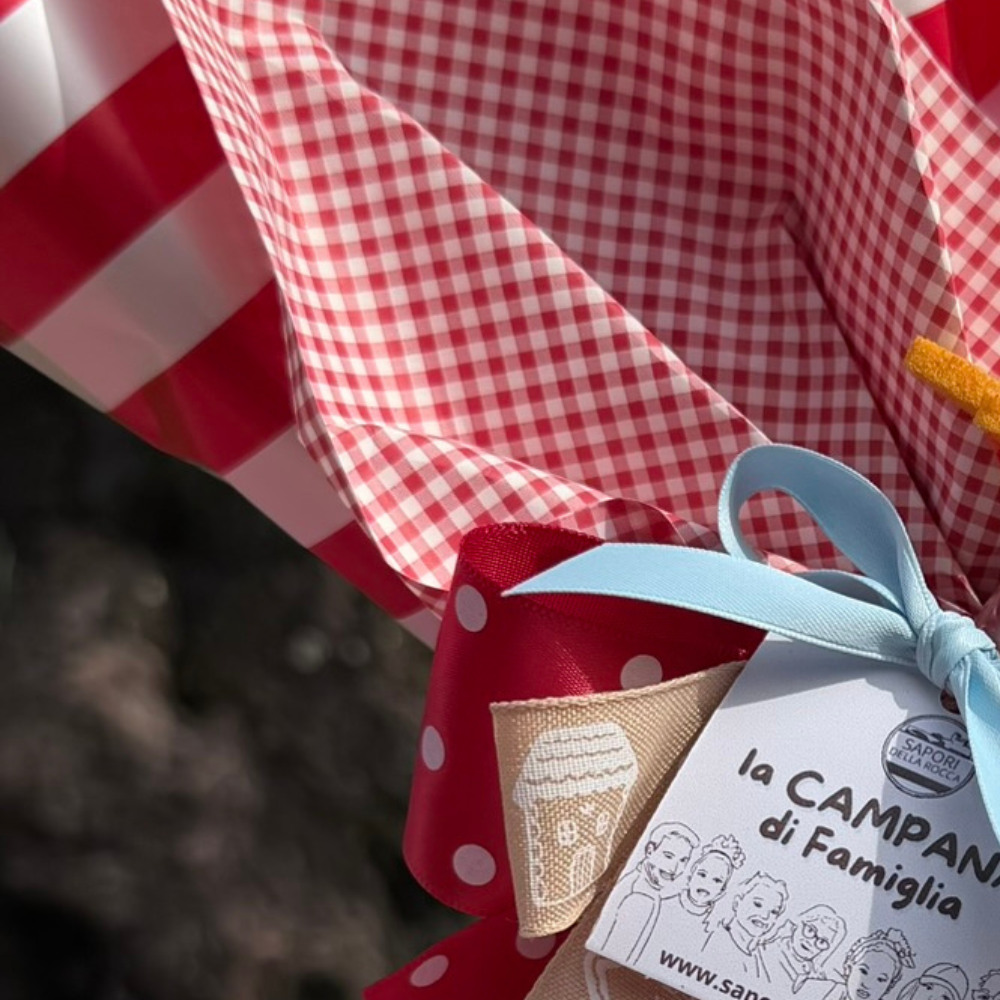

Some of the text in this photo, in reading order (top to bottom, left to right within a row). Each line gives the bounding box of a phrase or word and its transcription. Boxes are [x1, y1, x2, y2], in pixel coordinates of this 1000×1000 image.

[738, 748, 774, 786] la
[889, 747, 960, 782] DELLA ROCCA
[902, 738, 960, 770] SAPORI
[759, 809, 962, 920] di Famiglia
